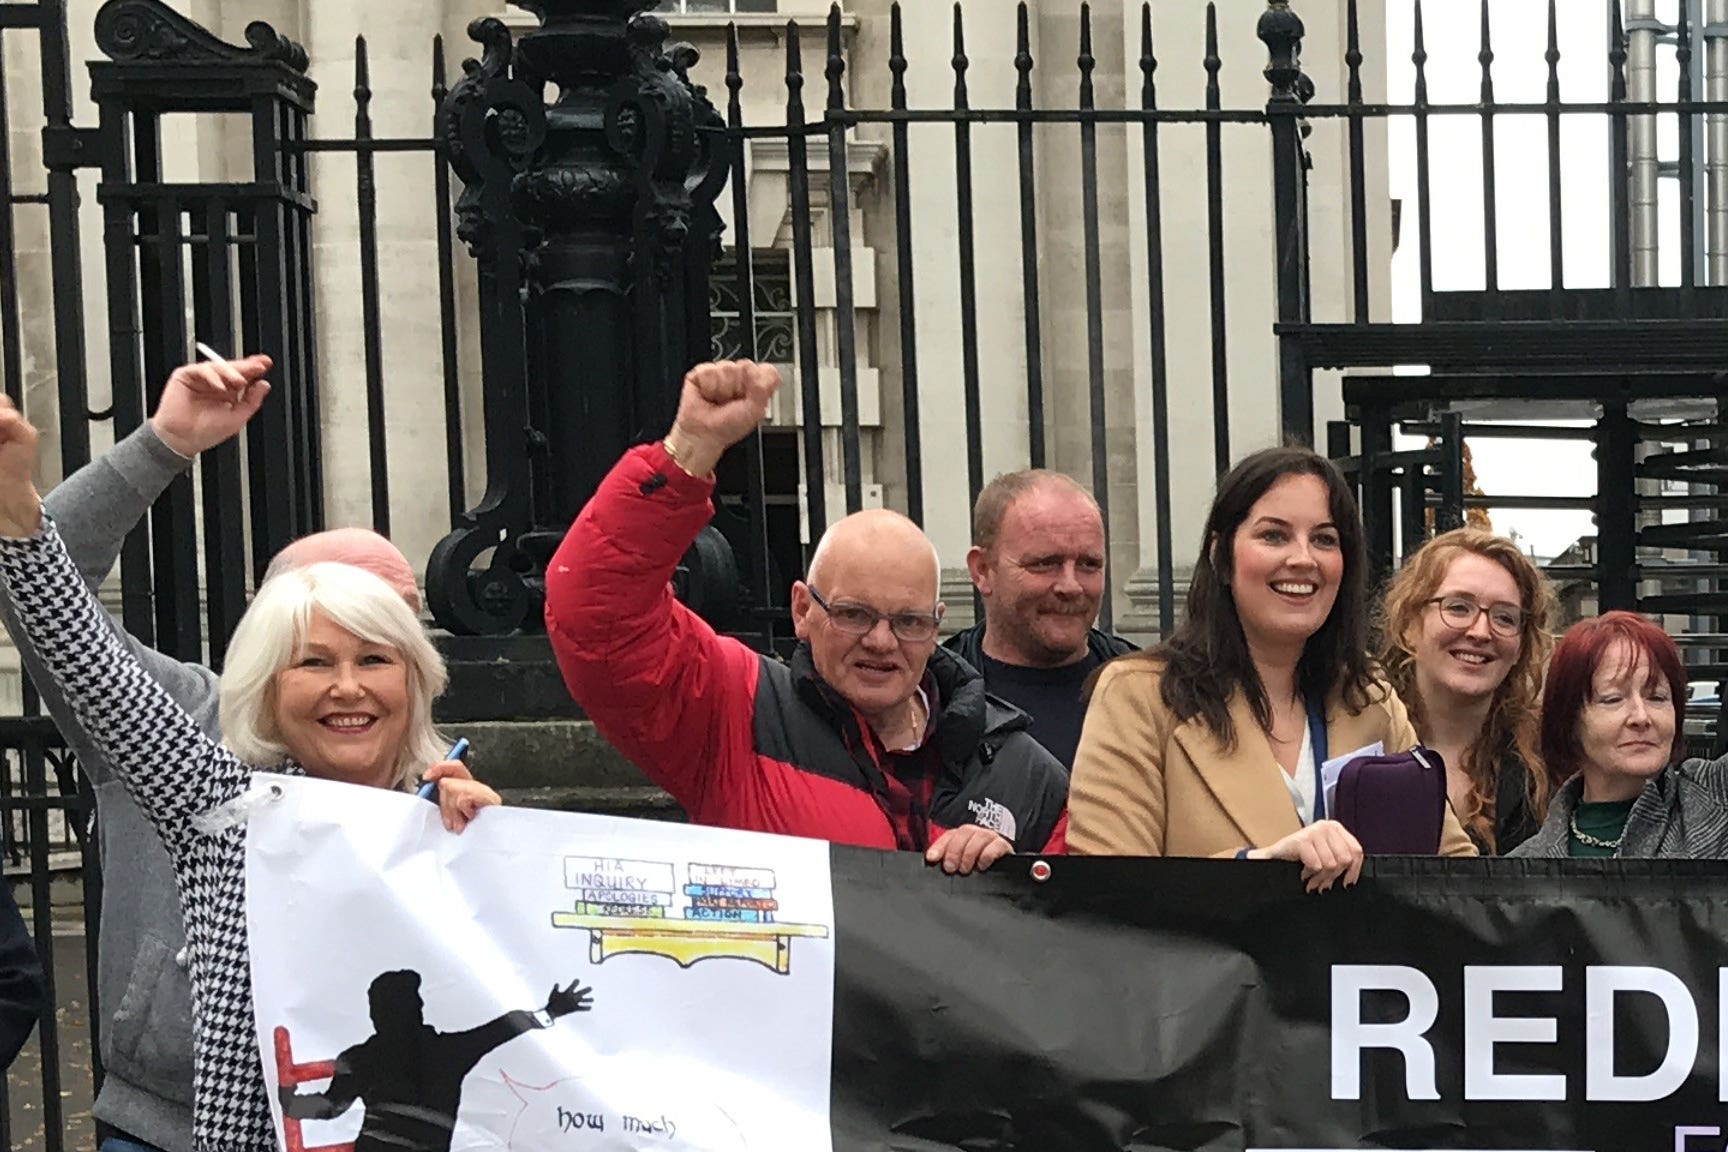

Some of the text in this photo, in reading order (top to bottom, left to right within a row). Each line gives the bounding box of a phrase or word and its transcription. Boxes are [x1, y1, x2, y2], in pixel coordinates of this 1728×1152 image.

[575, 871, 648, 890] INQUIRY
[586, 889, 659, 906] APOLOGIES
[692, 907, 742, 919] ACTION
[557, 1105, 676, 1139] how much
